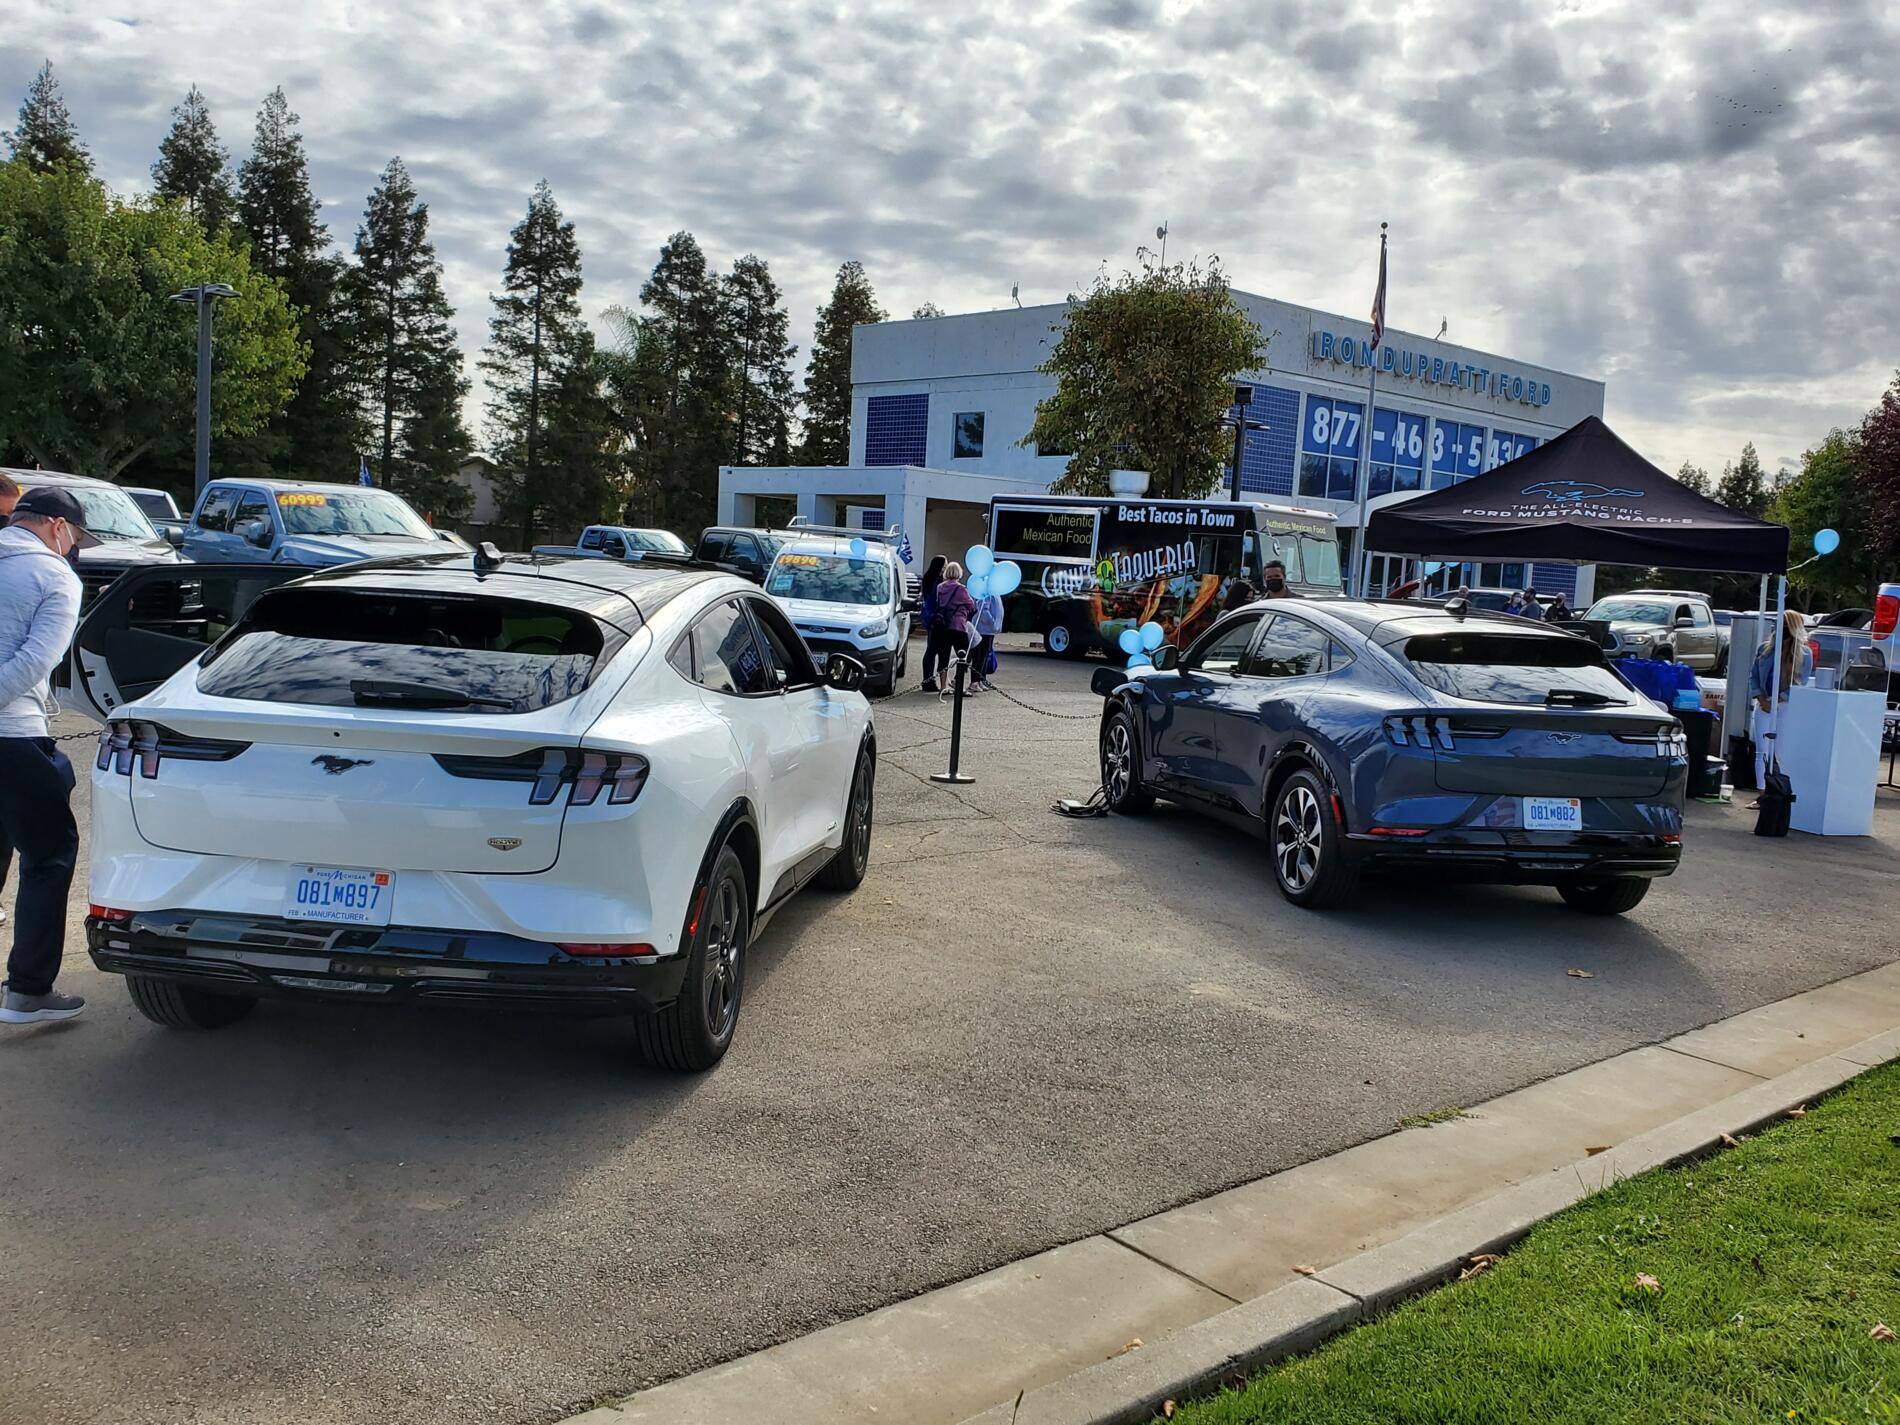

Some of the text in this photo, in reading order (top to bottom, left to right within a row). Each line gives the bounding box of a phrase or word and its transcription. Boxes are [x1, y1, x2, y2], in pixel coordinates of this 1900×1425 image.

[1319, 330, 1551, 407] RON DUPRATT FORD
[1118, 505, 1235, 527] Best Tacos in Town
[1462, 508, 1693, 524] FORD MUSTANG MACH-E
[1542, 502, 1643, 515] ALL-ELECTRIC
[1047, 513, 1094, 528] Authentic
[1023, 527, 1093, 544] Mexican Food
[1111, 540, 1196, 584] TAQUERIA
[297, 879, 380, 910] 081M897
[306, 910, 365, 921] MANUFACTURER
